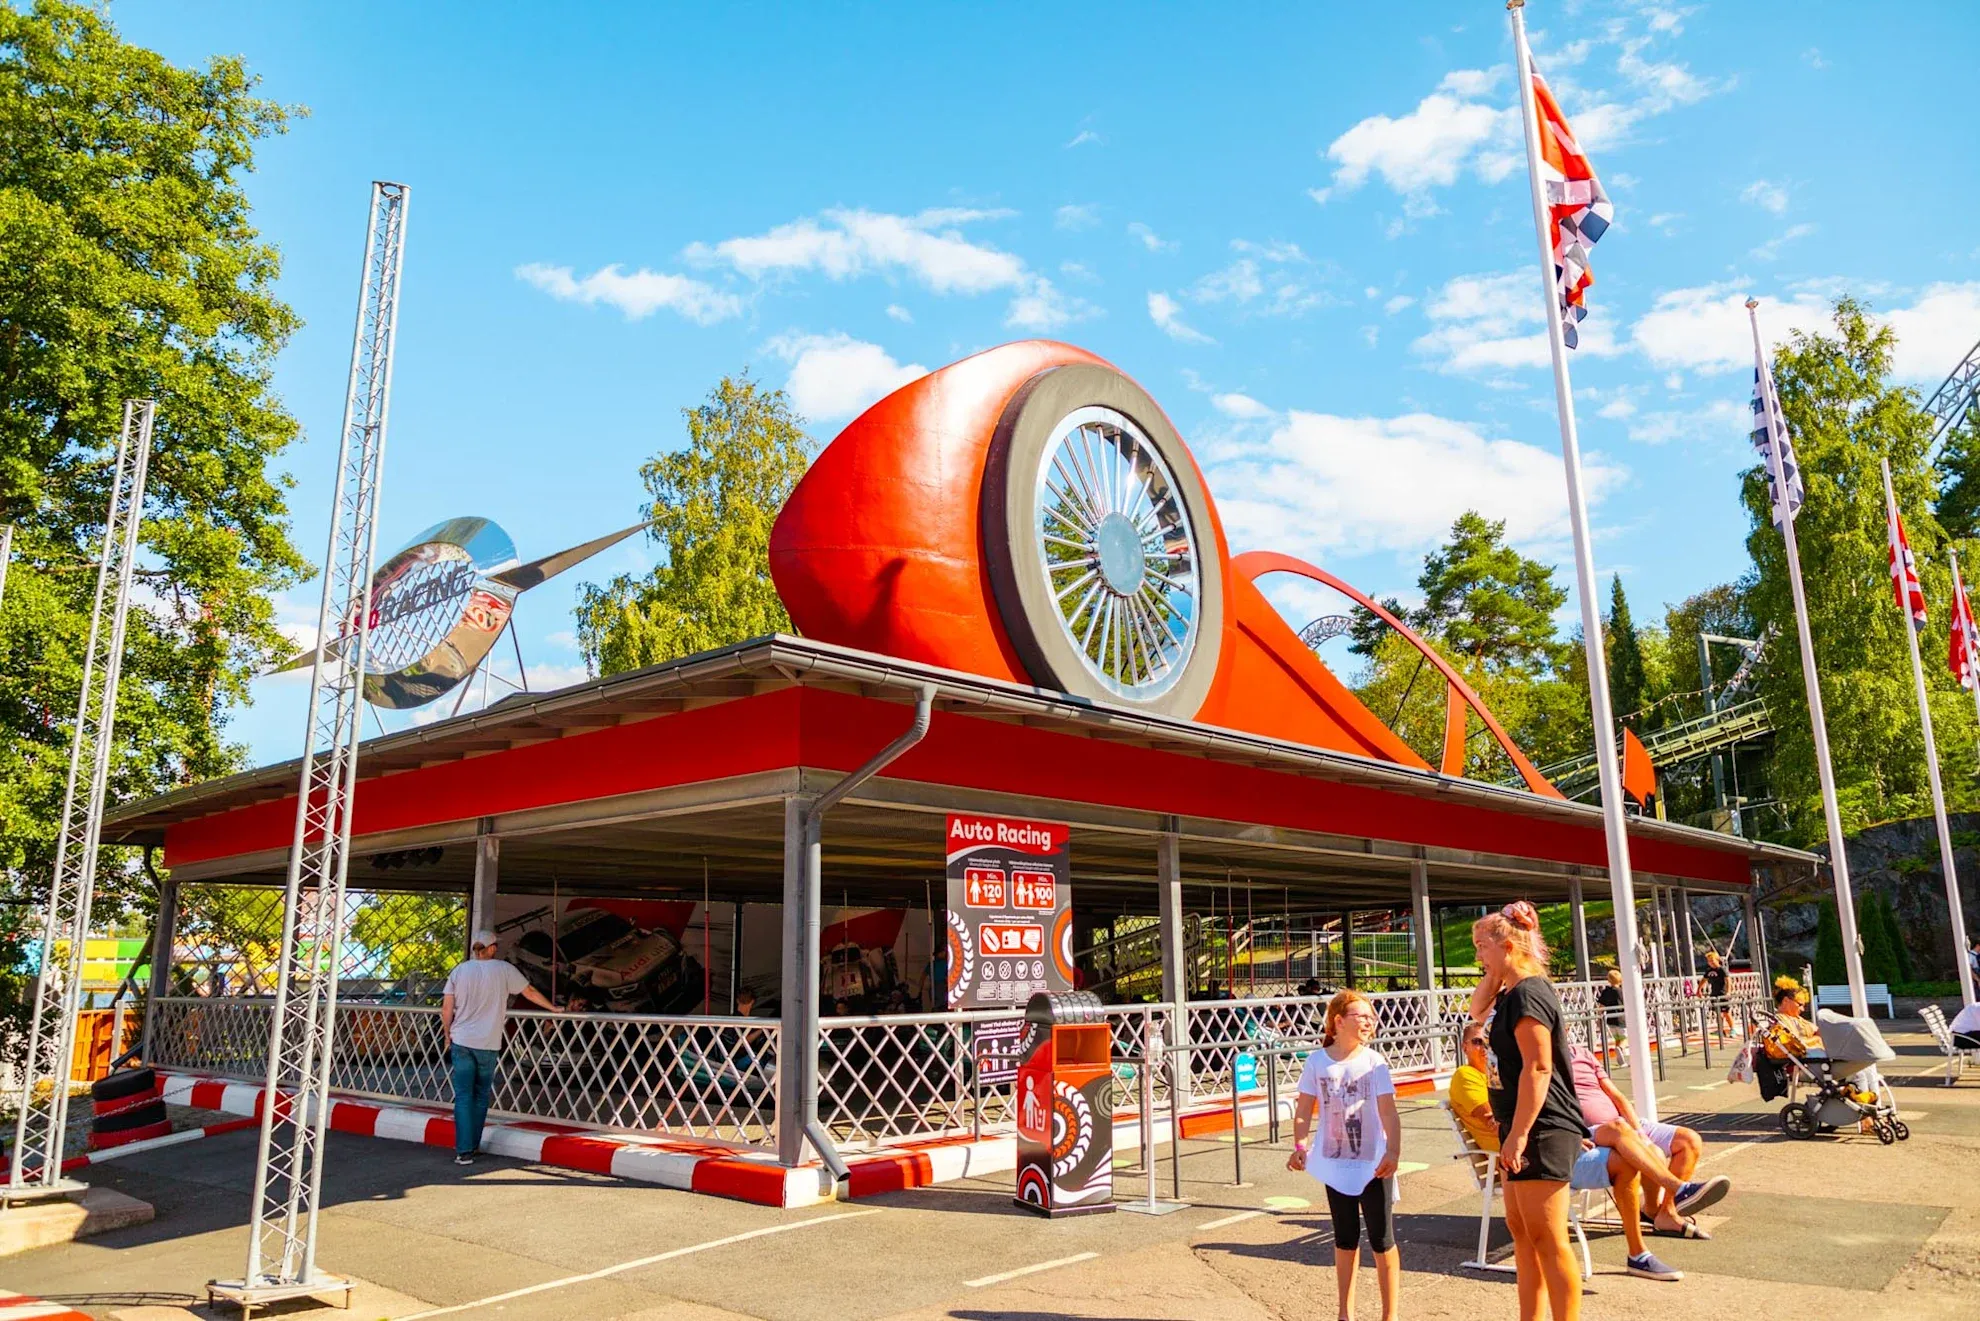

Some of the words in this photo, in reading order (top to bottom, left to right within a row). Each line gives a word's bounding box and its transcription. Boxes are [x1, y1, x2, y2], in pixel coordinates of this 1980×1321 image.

[380, 565, 468, 626] RACING
[949, 819, 994, 841] Auto
[997, 822, 1051, 851] Racing
[986, 872, 999, 880] Min.
[983, 885, 1002, 898] 120
[1034, 887, 1053, 900] 100
[620, 955, 651, 981] Audi
